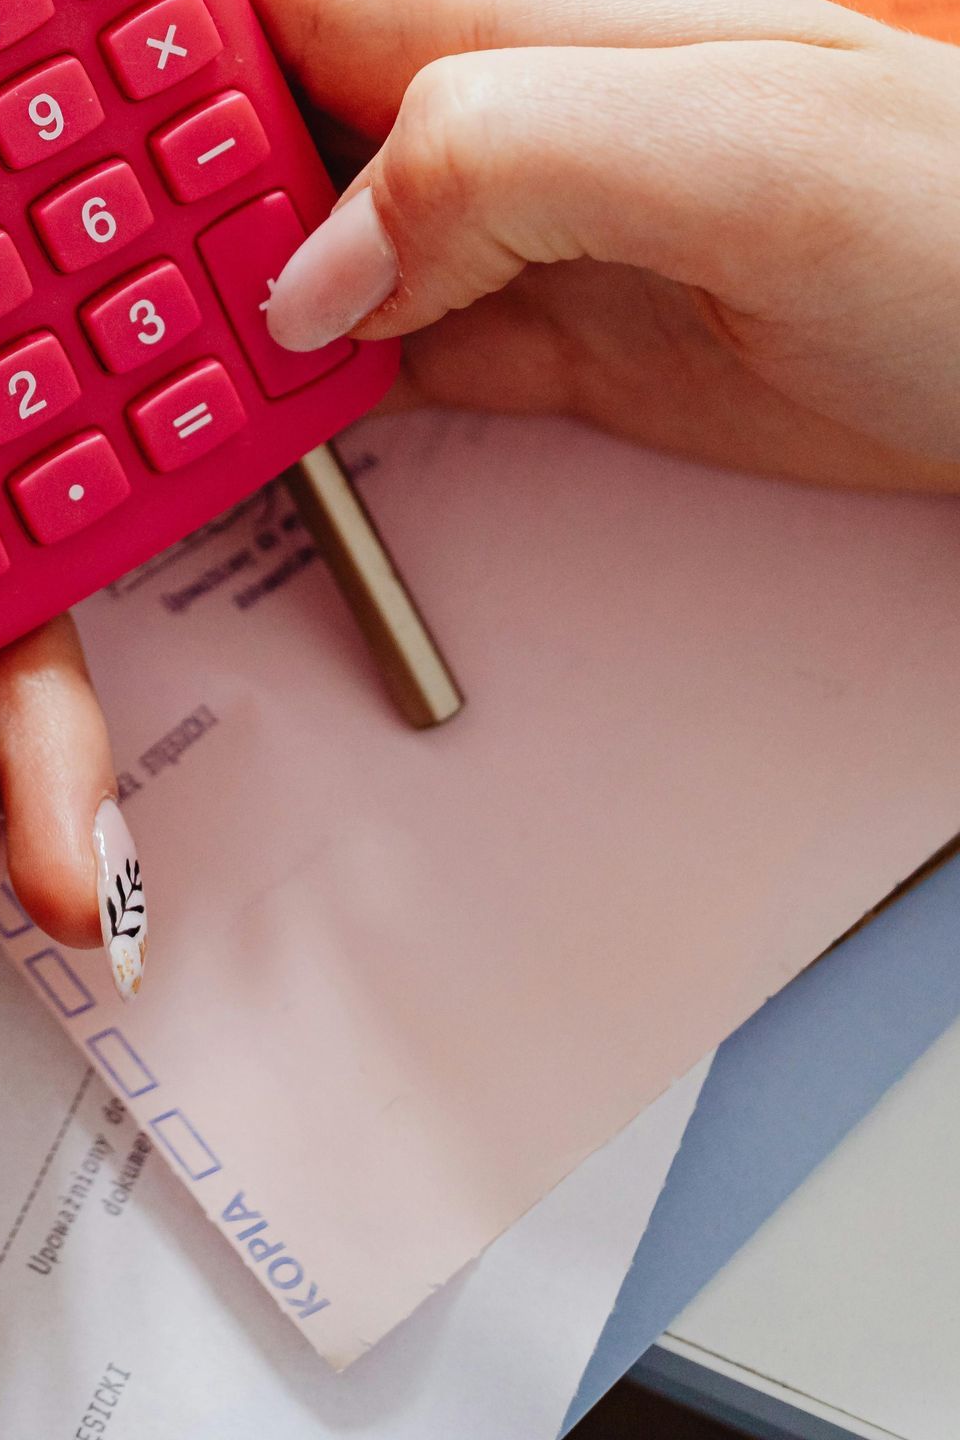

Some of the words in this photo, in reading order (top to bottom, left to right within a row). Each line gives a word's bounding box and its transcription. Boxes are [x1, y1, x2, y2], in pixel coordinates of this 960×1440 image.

[28, 92, 65, 141] 9
[80, 196, 118, 243] 6
[129, 299, 166, 345] 3
[8, 370, 47, 420] 2
[220, 1191, 332, 1320] KOPIA
